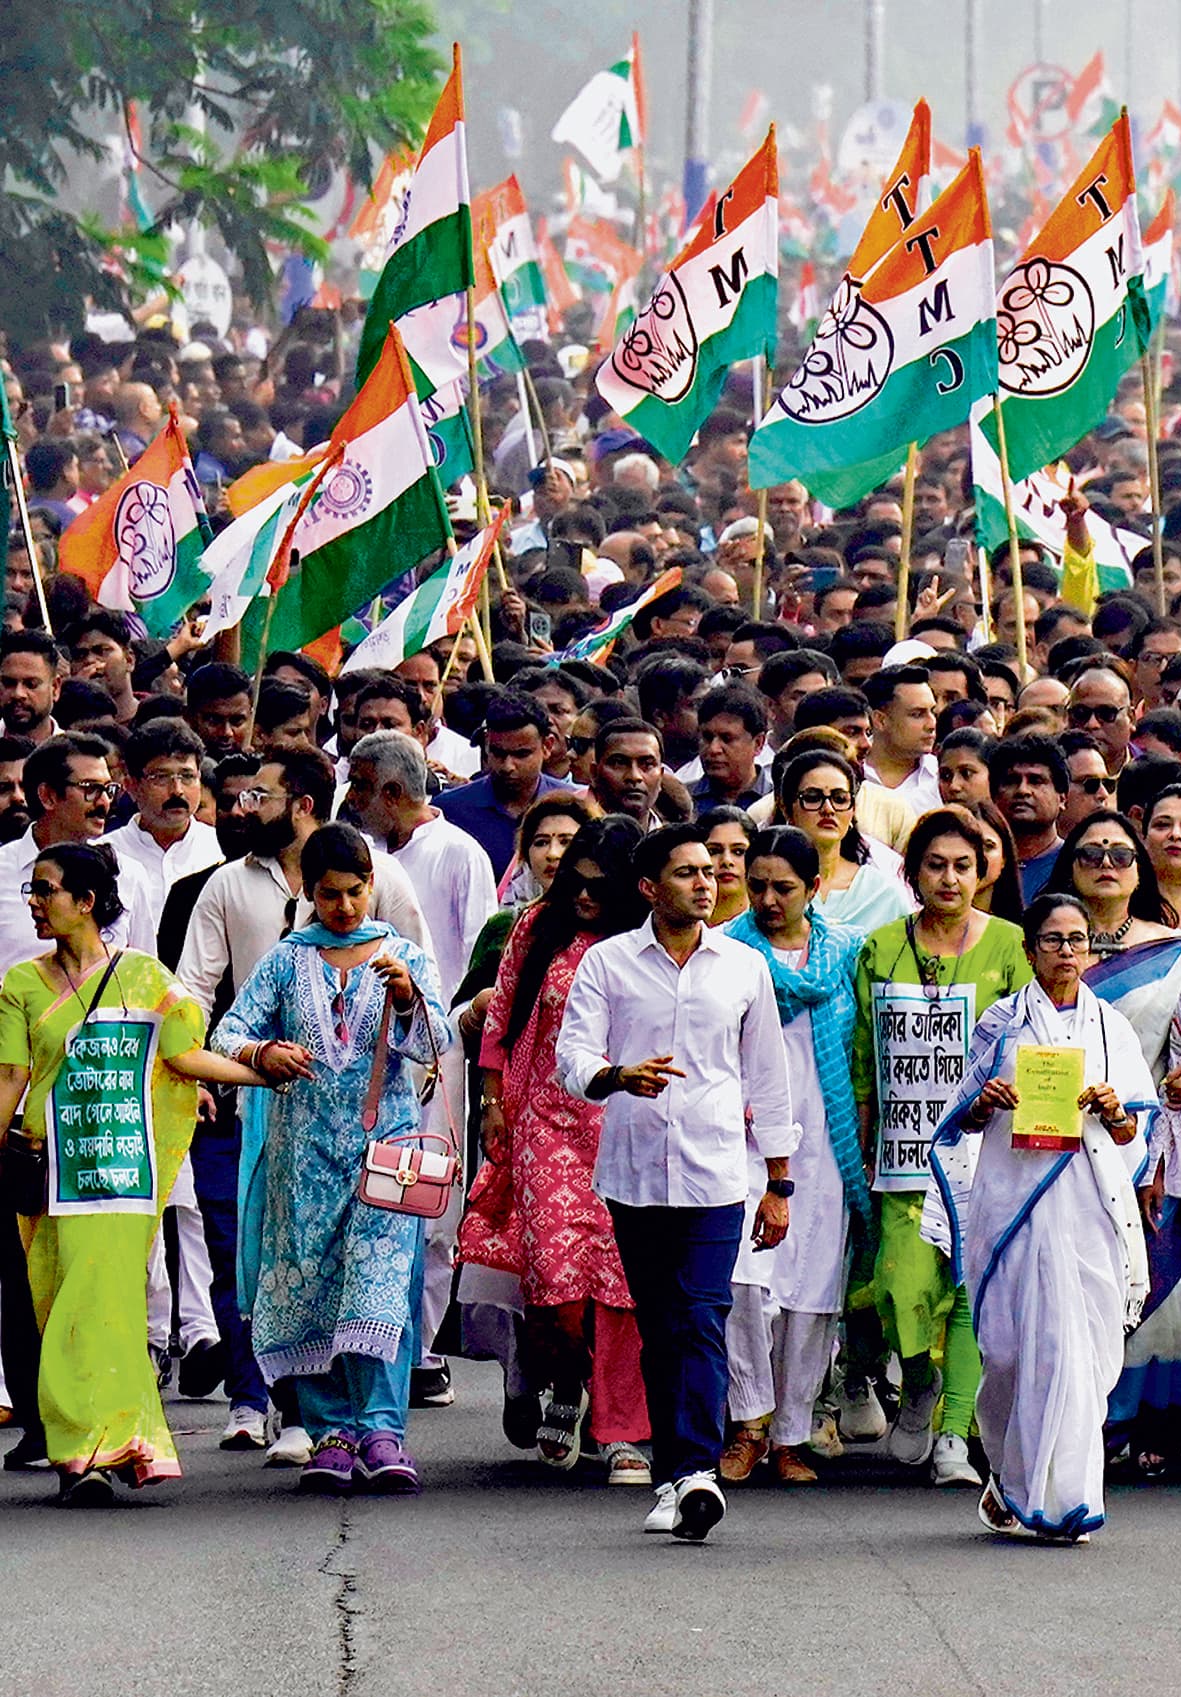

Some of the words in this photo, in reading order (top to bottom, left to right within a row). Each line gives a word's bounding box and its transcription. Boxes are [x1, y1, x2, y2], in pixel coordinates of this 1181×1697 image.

[911, 1003, 962, 1042] তালিকা
[120, 1026, 140, 1057] বৈধ
[67, 1065, 117, 1092] ভোটারের
[118, 1070, 135, 1091] নাম
[893, 1055, 931, 1085] করতে
[934, 1045, 963, 1085] গিয়ে
[59, 1104, 82, 1127] বাদ
[86, 1103, 112, 1124] গেলে
[64, 1138, 75, 1158] ও
[78, 1129, 114, 1159] ময়দানি
[115, 1129, 145, 1159] লড়াই
[77, 1168, 111, 1191] চলছে
[109, 1168, 141, 1189] চলবে
